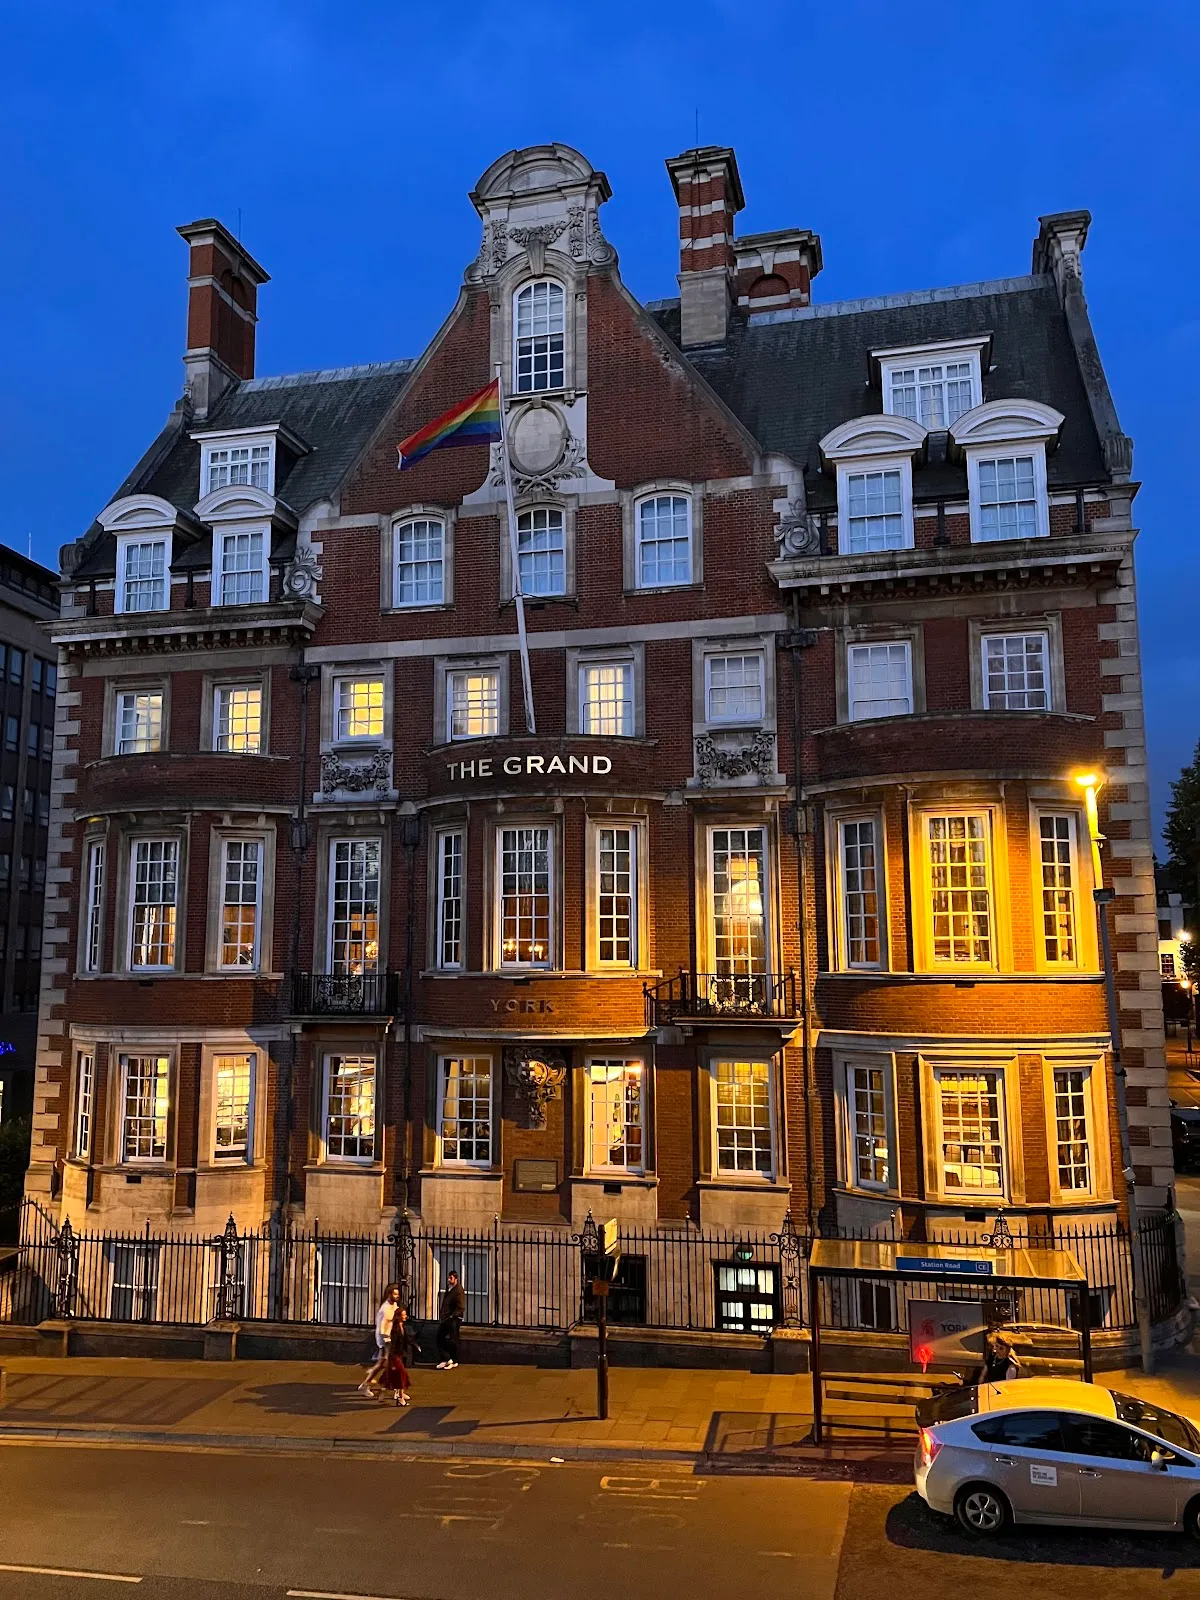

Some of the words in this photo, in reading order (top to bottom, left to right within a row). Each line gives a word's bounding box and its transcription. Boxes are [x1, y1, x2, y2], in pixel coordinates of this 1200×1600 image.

[447, 758, 494, 781] THE
[503, 755, 613, 775] GRAND
[490, 999, 554, 1013] YORK
[920, 1261, 944, 1269] Station
[977, 1263, 987, 1271] CE
